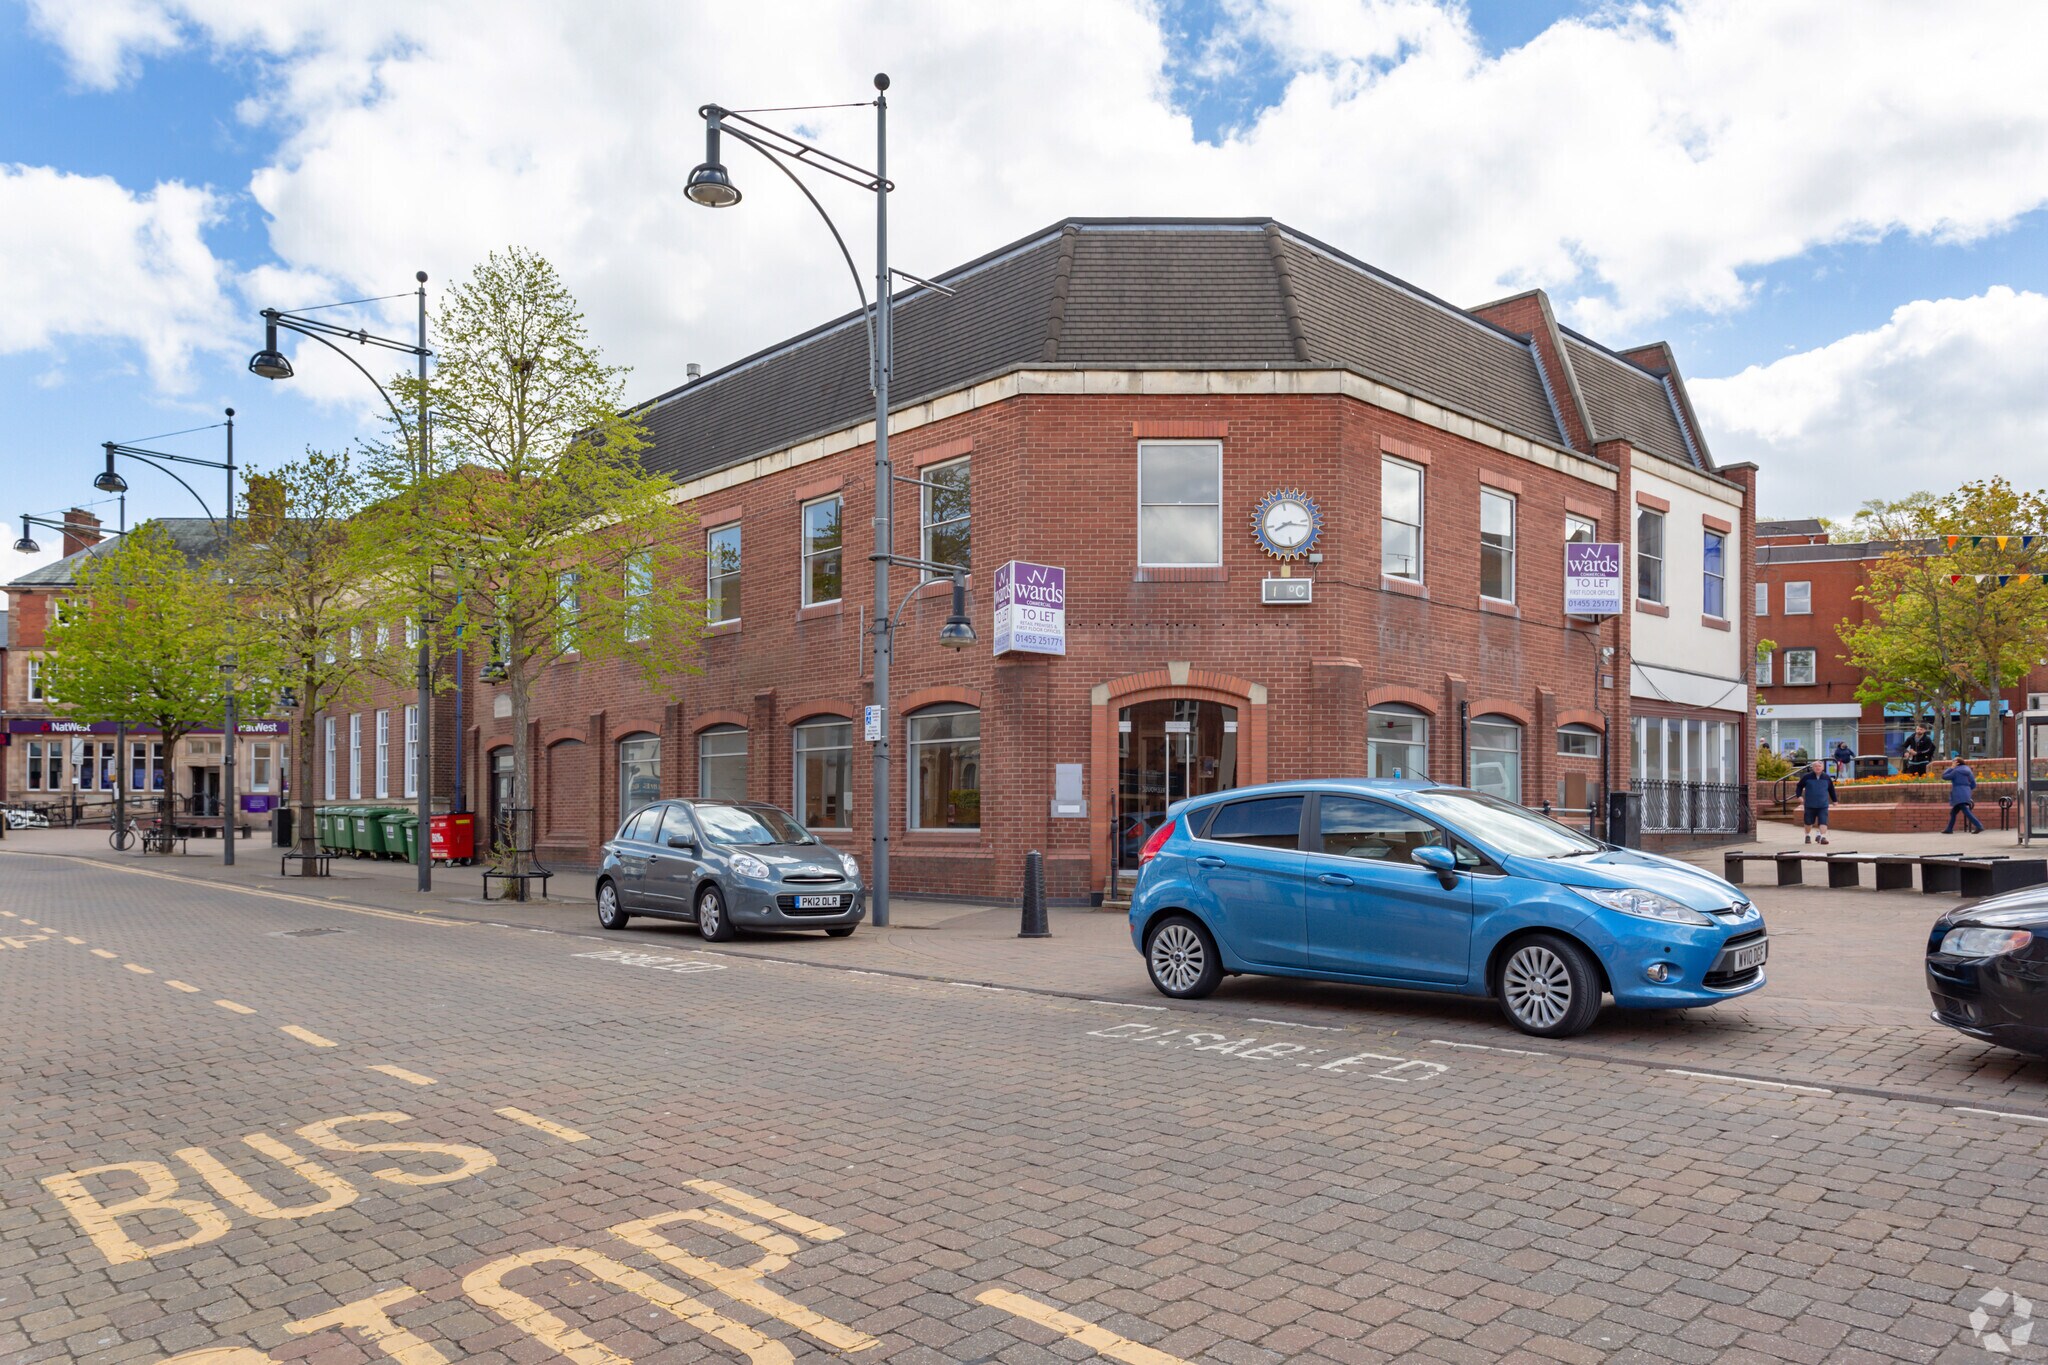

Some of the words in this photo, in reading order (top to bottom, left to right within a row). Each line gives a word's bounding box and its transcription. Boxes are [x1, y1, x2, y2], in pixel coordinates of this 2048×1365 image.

[1569, 555, 1618, 573] wards
[1576, 578, 1590, 588] TO
[1594, 578, 1610, 588] LET
[1015, 582, 1063, 603] wards
[1022, 608, 1036, 620] TO
[1039, 611, 1055, 622] LET
[1015, 634, 1037, 644] 01455
[1038, 636, 1063, 646] 251771
[51, 722, 91, 732] NatWest
[802, 897, 820, 906] PK12
[822, 896, 838, 906] OLR
[41, 1111, 498, 1265] BUS
